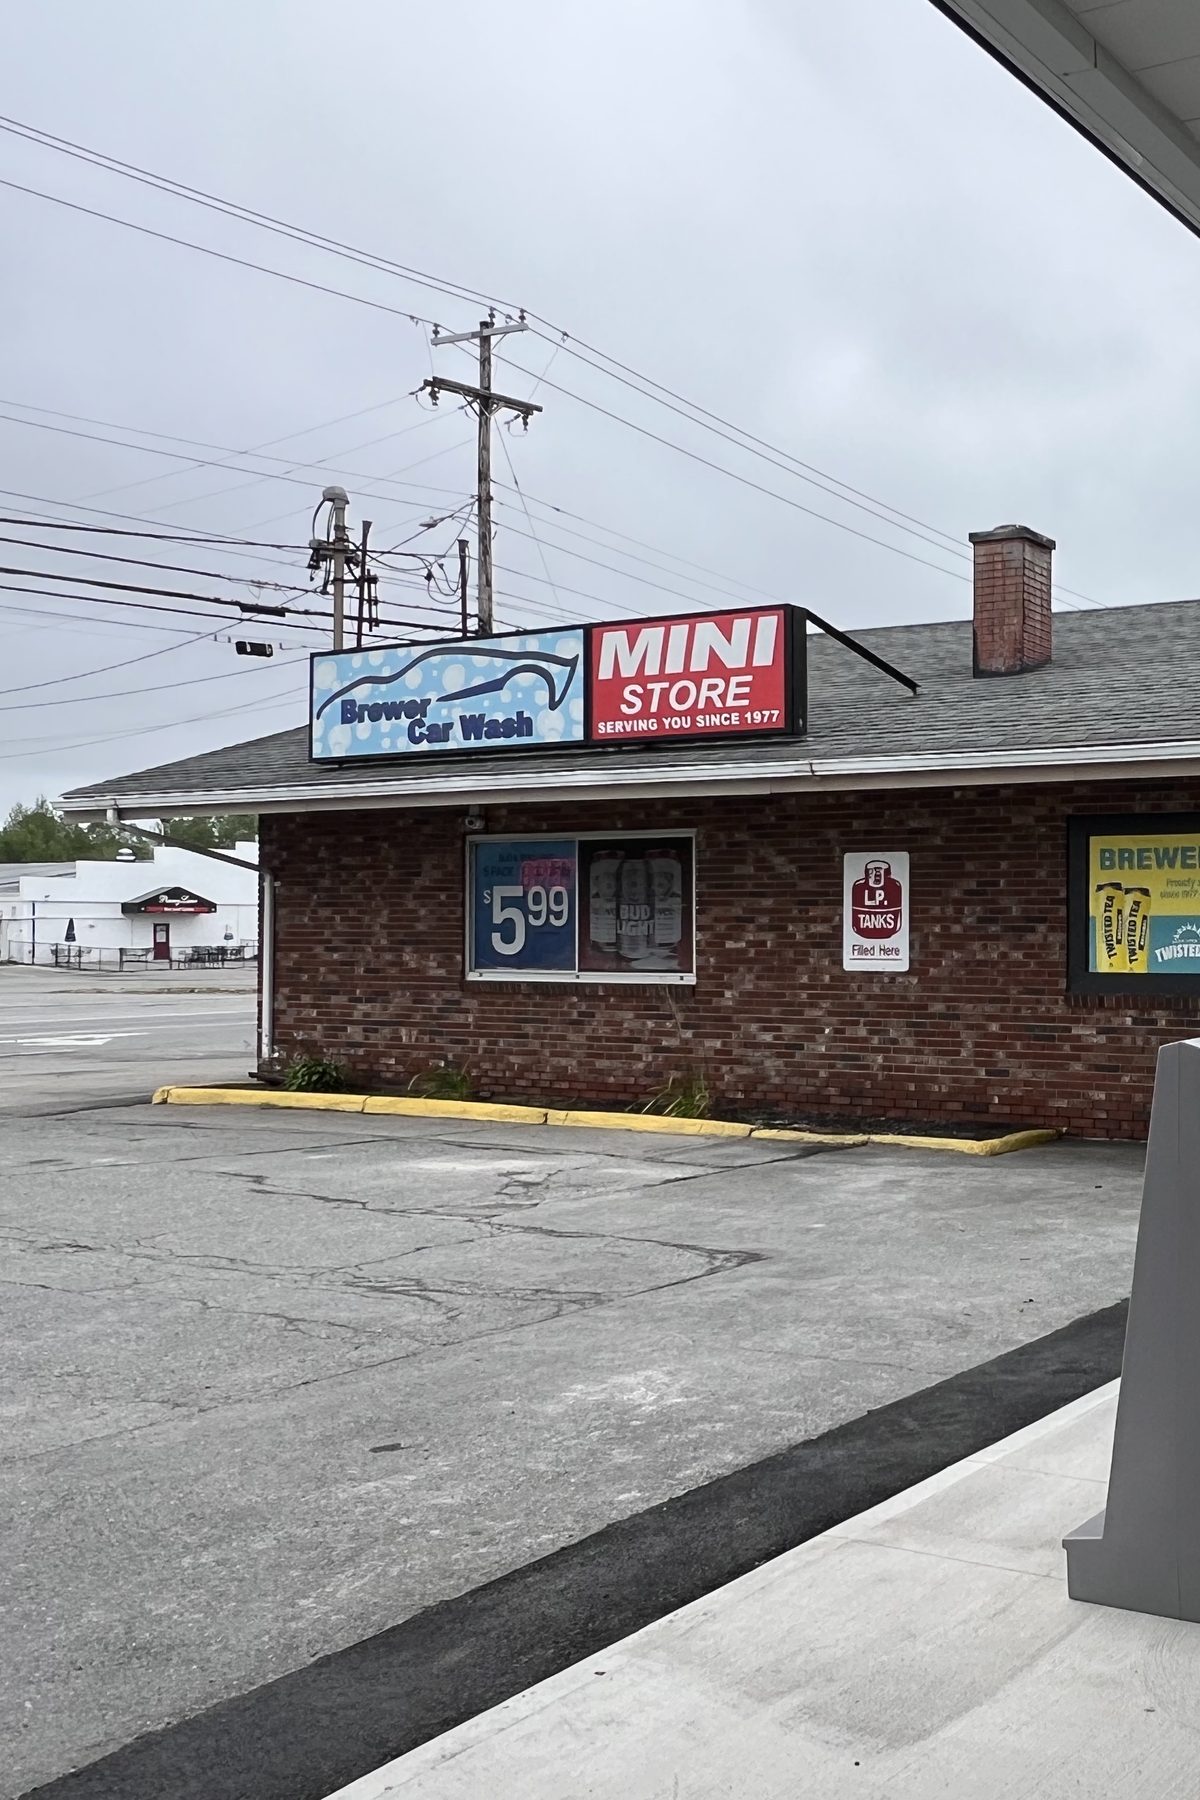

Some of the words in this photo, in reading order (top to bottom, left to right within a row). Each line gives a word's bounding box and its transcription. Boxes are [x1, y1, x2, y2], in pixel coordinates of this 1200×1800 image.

[598, 614, 779, 681] MINI
[620, 675, 752, 715] STORE
[340, 698, 432, 725] Brewer
[598, 717, 658, 733] SERVING
[662, 715, 692, 730] YOU
[695, 712, 741, 728] SINCE
[744, 709, 779, 725] 1977
[407, 719, 451, 745] Car
[460, 710, 533, 742] Wash
[620, 904, 651, 920] BUD
[858, 914, 895, 929] TANKS
[852, 944, 875, 956] Filled
[880, 944, 900, 956] Here
